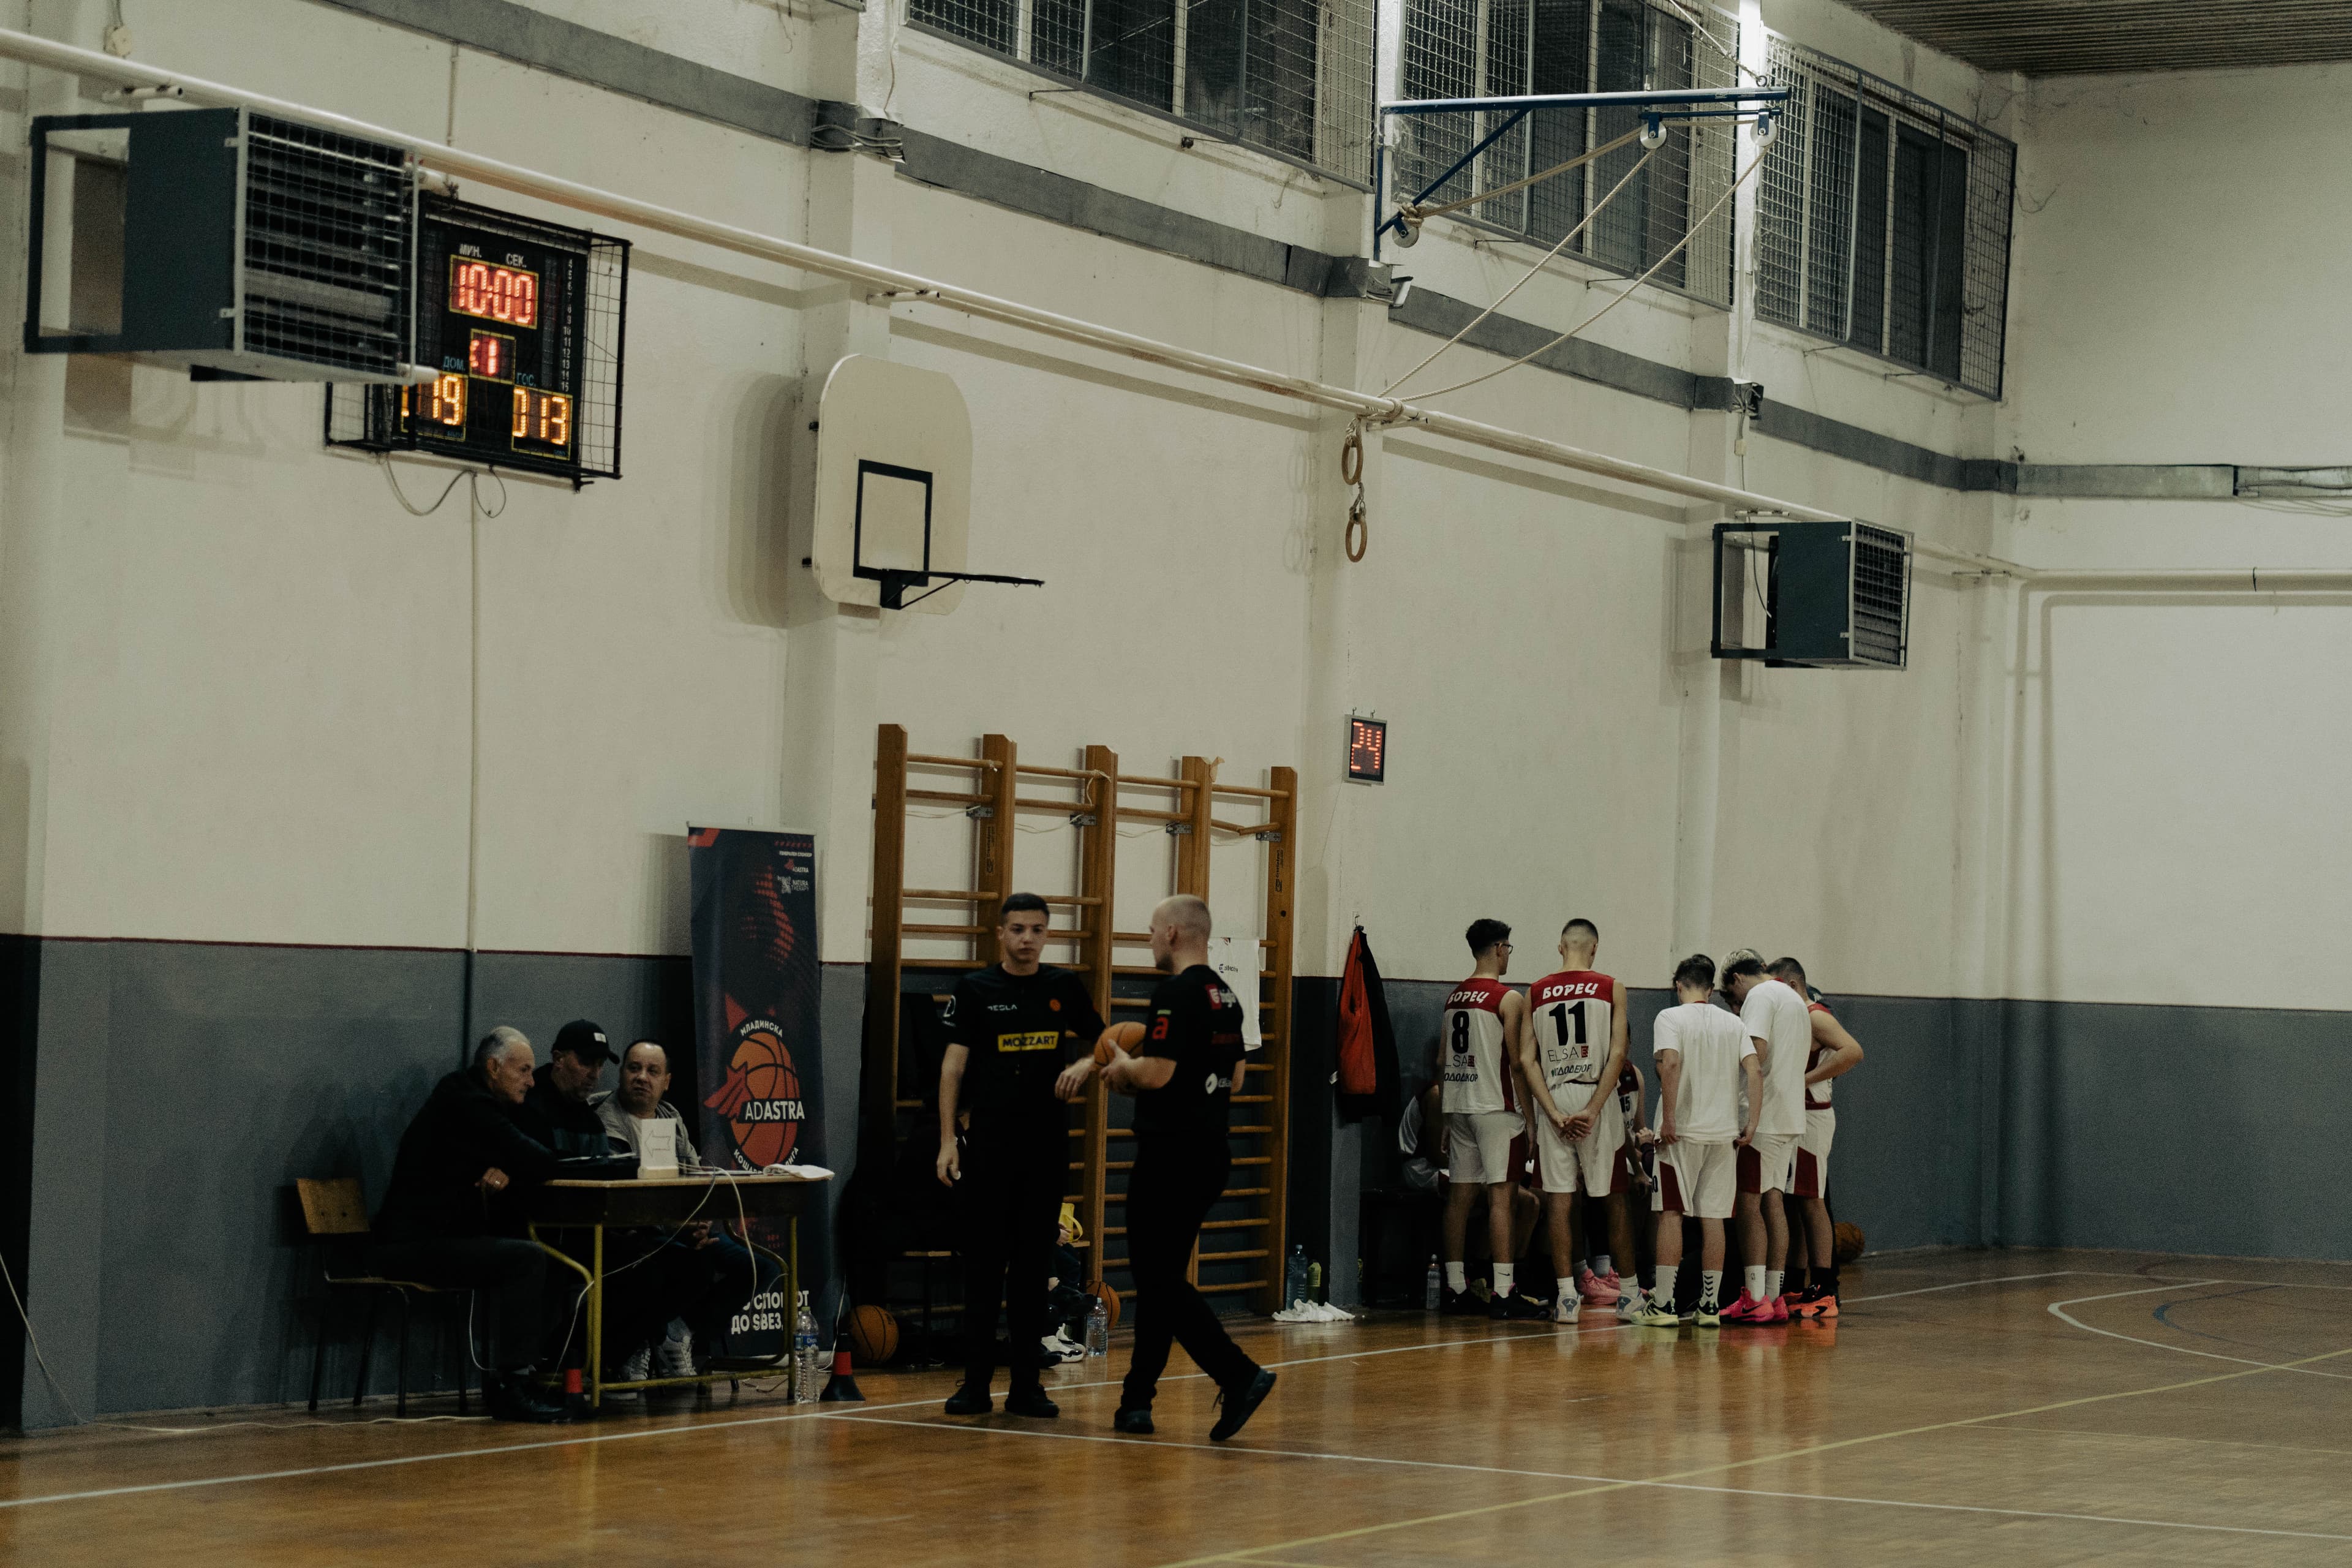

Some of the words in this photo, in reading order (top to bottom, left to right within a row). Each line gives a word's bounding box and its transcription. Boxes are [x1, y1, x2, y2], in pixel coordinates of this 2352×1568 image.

[459, 264, 533, 324] 10:00
[1351, 722, 1382, 769] 24
[1447, 991, 1490, 1005] БОРЕЦ
[1542, 982, 1599, 1000] БОРЕЦ
[740, 1019, 783, 1038] МЛАДИНСКА
[1452, 1011, 1469, 1054] 8
[1549, 1001, 1587, 1046] 11
[1003, 1035, 1055, 1048] MOZZART
[1445, 1054, 1468, 1068] LSA
[1547, 1046, 1579, 1063] ELSA
[745, 1101, 805, 1121] ADASTRA
[731, 1314, 750, 1335] ДО
